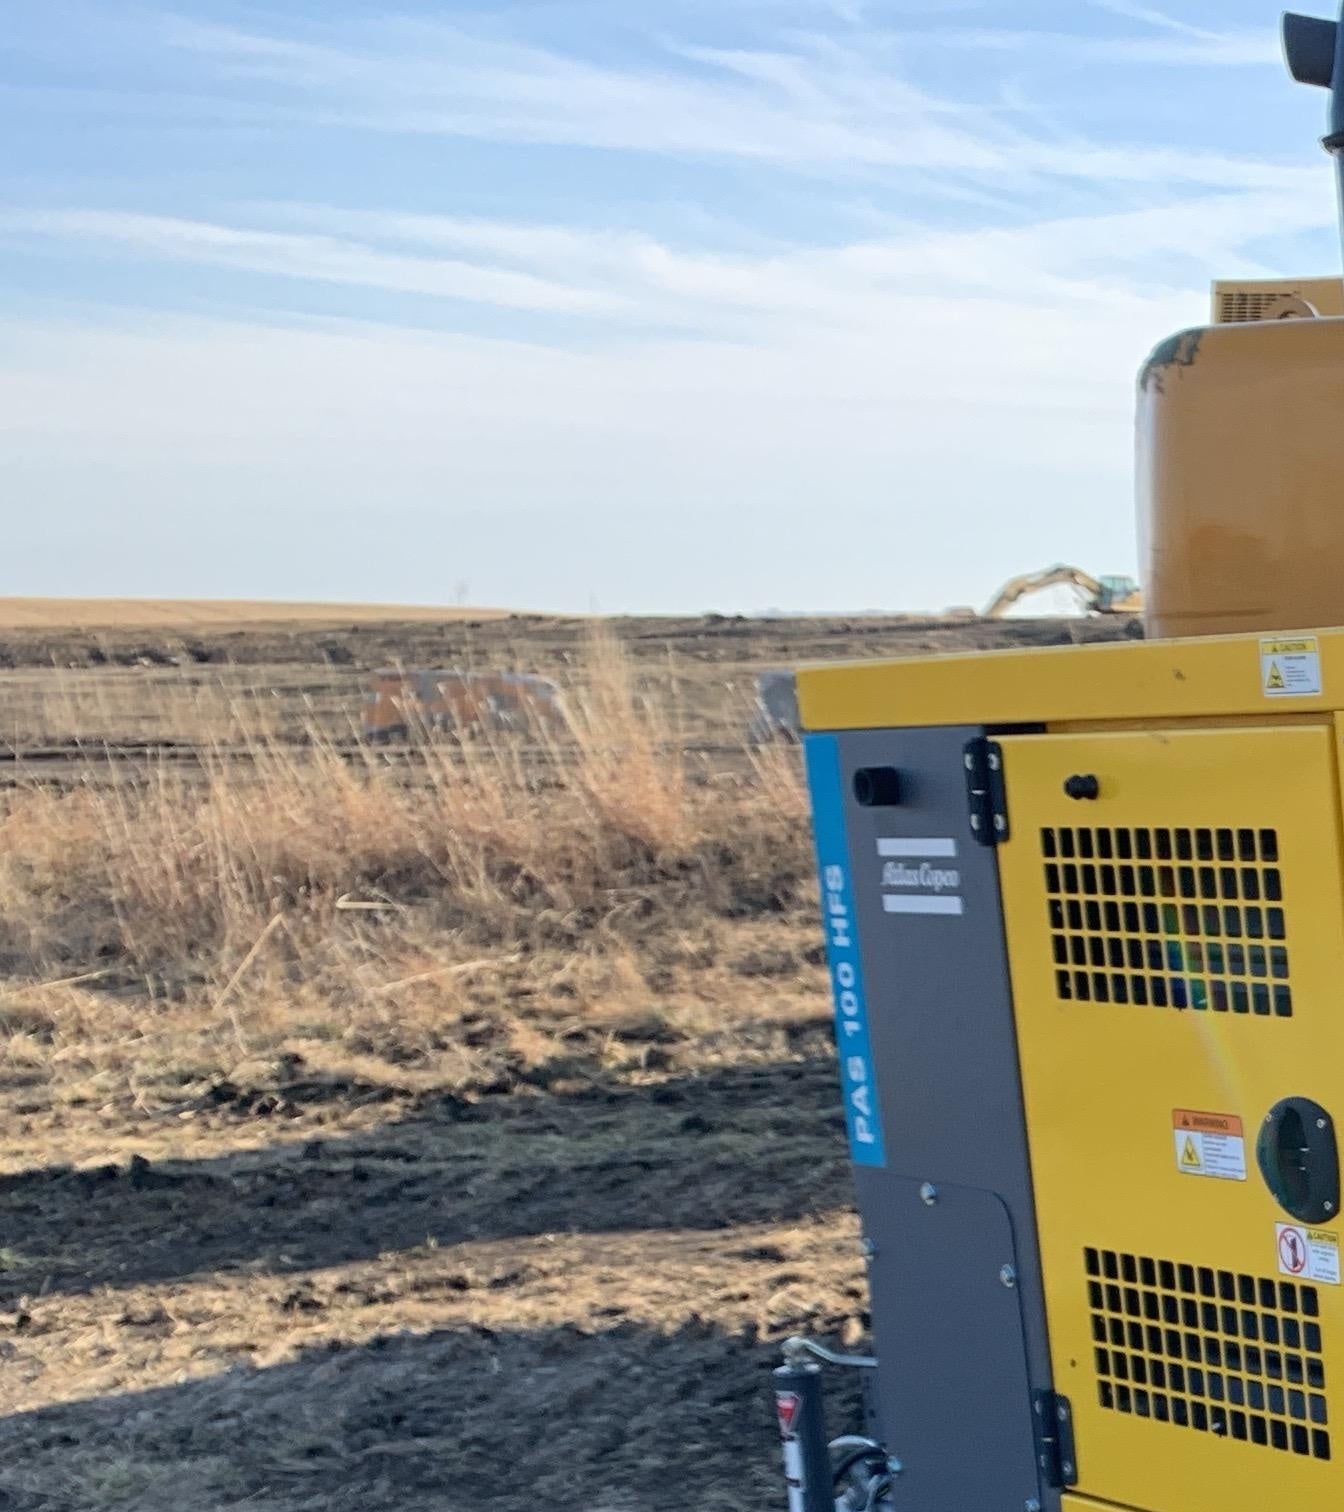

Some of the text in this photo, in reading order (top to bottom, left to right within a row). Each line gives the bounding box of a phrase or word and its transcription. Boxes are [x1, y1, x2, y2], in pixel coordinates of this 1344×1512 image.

[824, 863, 875, 1146] PAS 100 HFS
